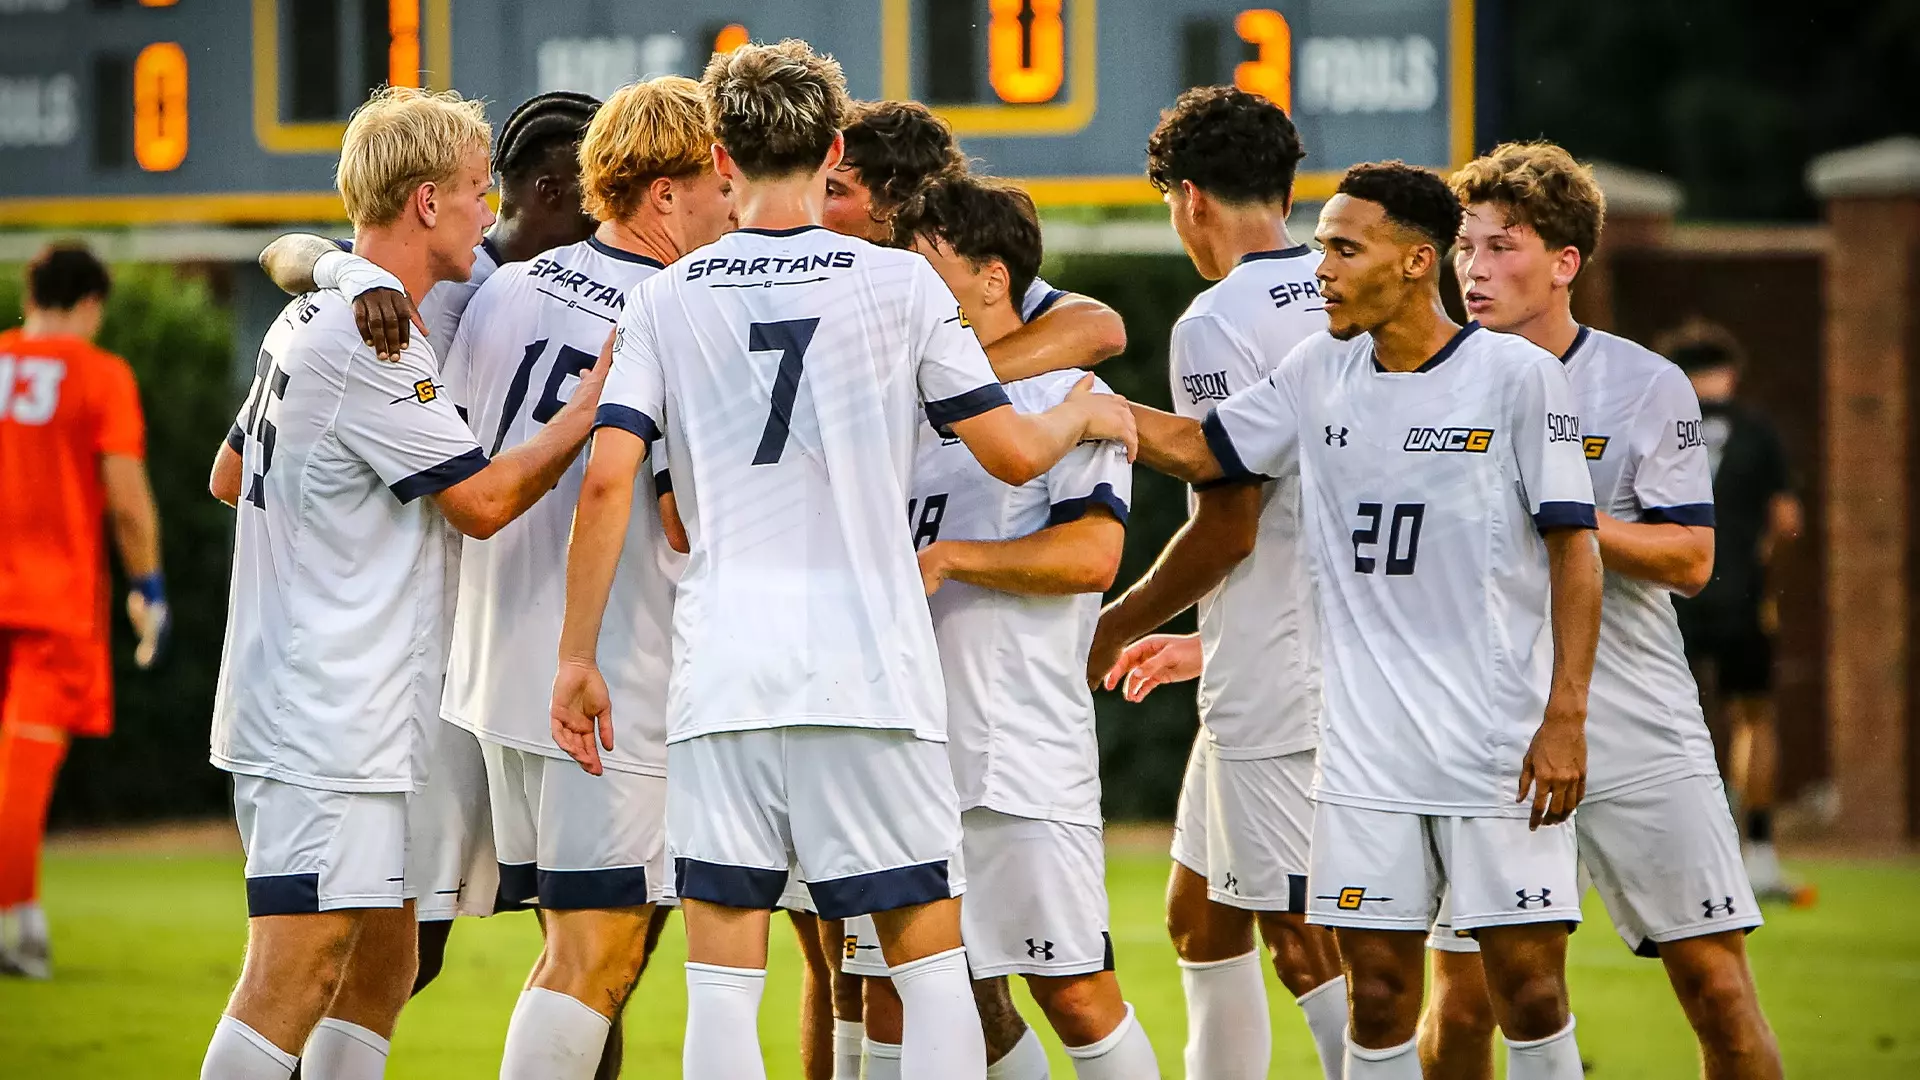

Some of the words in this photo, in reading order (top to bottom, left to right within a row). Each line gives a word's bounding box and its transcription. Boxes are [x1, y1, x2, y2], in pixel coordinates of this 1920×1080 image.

[134, 41, 188, 172] 0
[686, 252, 856, 282] SPARTANS
[1269, 279, 1321, 309] SPA
[749, 318, 821, 466] 7
[1403, 427, 1496, 453] UNCG
[1351, 503, 1426, 575] 20
